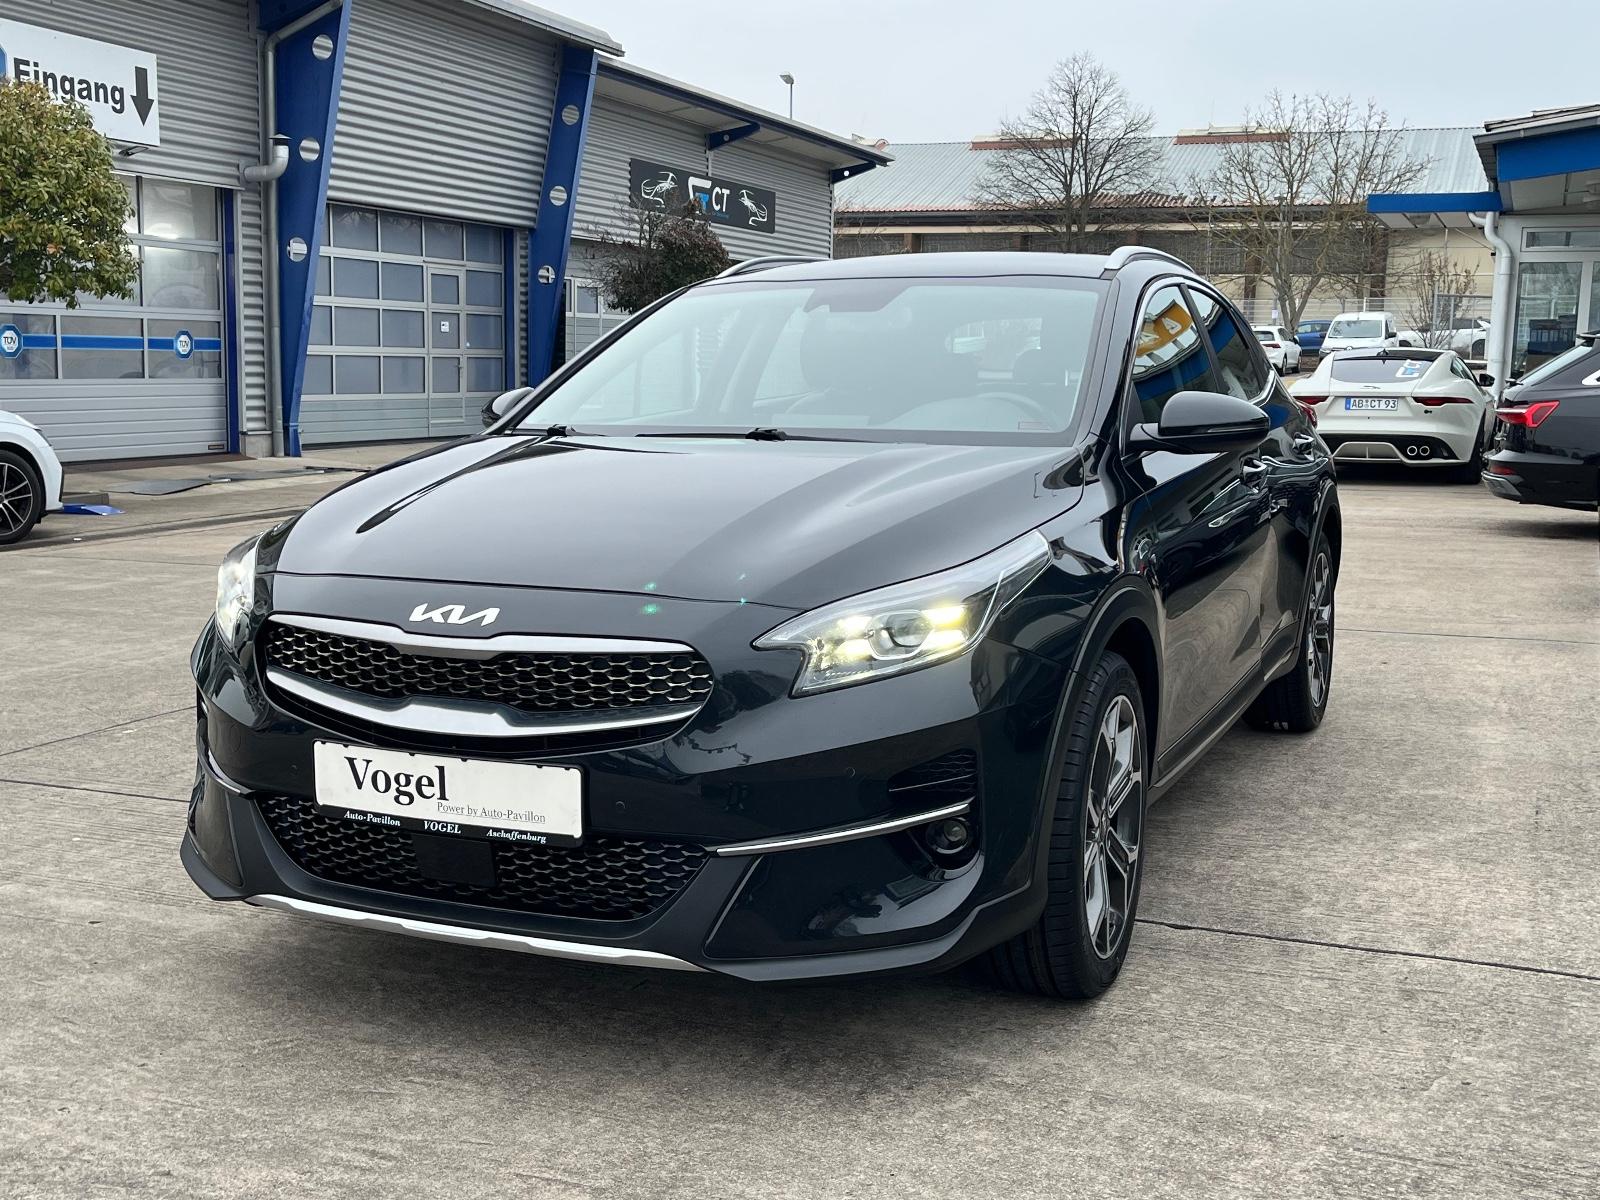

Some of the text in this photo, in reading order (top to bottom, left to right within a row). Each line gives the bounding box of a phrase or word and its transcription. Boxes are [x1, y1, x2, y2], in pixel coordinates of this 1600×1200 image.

[13, 57, 125, 114] Eingang
[1351, 399, 1397, 409] AB CT 93
[344, 756, 449, 806] Vogel
[343, 810, 547, 845] Auto-Pavillon VOGEL Aschaffenburg
[436, 801, 546, 825] Power by Auto-Pavillon
